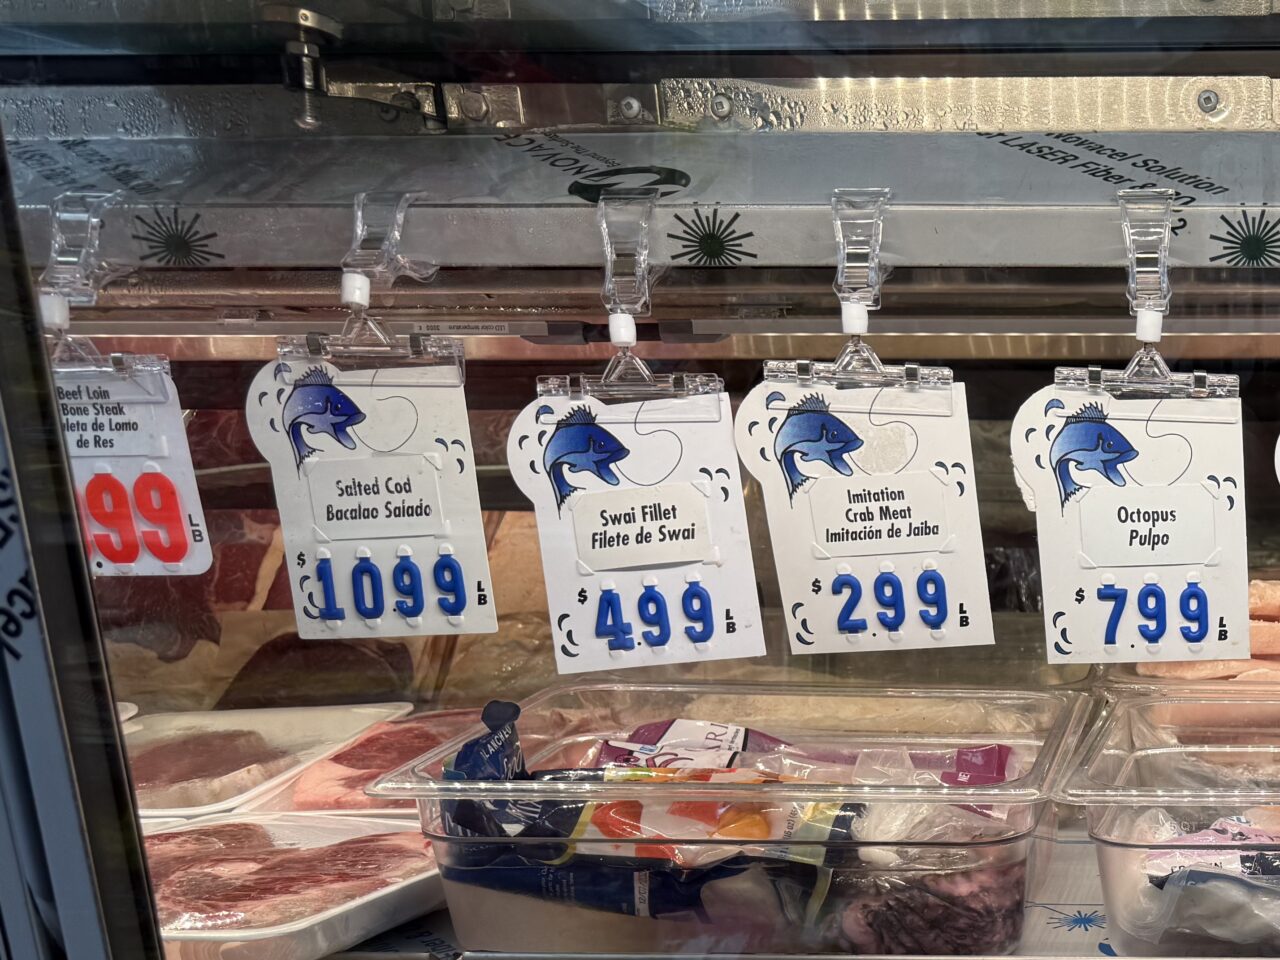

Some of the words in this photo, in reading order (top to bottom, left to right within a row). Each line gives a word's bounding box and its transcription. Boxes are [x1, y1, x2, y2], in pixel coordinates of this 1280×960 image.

[1000, 136, 1080, 165] LASER
[1069, 160, 1136, 189] Fiber
[1132, 153, 1229, 195] Solution
[82, 386, 110, 400] Loin
[95, 402, 125, 417] Steak
[92, 419, 105, 431] de
[108, 419, 138, 432] Lomo
[77, 435, 90, 447] de
[94, 435, 114, 448] Res
[335, 477, 380, 497] Salted
[385, 476, 412, 495] Cod
[847, 487, 905, 504] Imitation
[326, 502, 382, 522] Bacalao
[600, 506, 636, 526] Swai
[641, 503, 677, 523] Fillet
[845, 508, 875, 523] Crab
[879, 505, 912, 521] Meat
[1117, 506, 1177, 527] Octopus
[591, 530, 630, 550] Filete
[635, 528, 652, 544] de
[658, 523, 696, 542] Swai
[826, 525, 882, 543] Imitación
[887, 523, 902, 539] de
[906, 521, 939, 538] Jaiba
[1128, 528, 1170, 550] Pulpo
